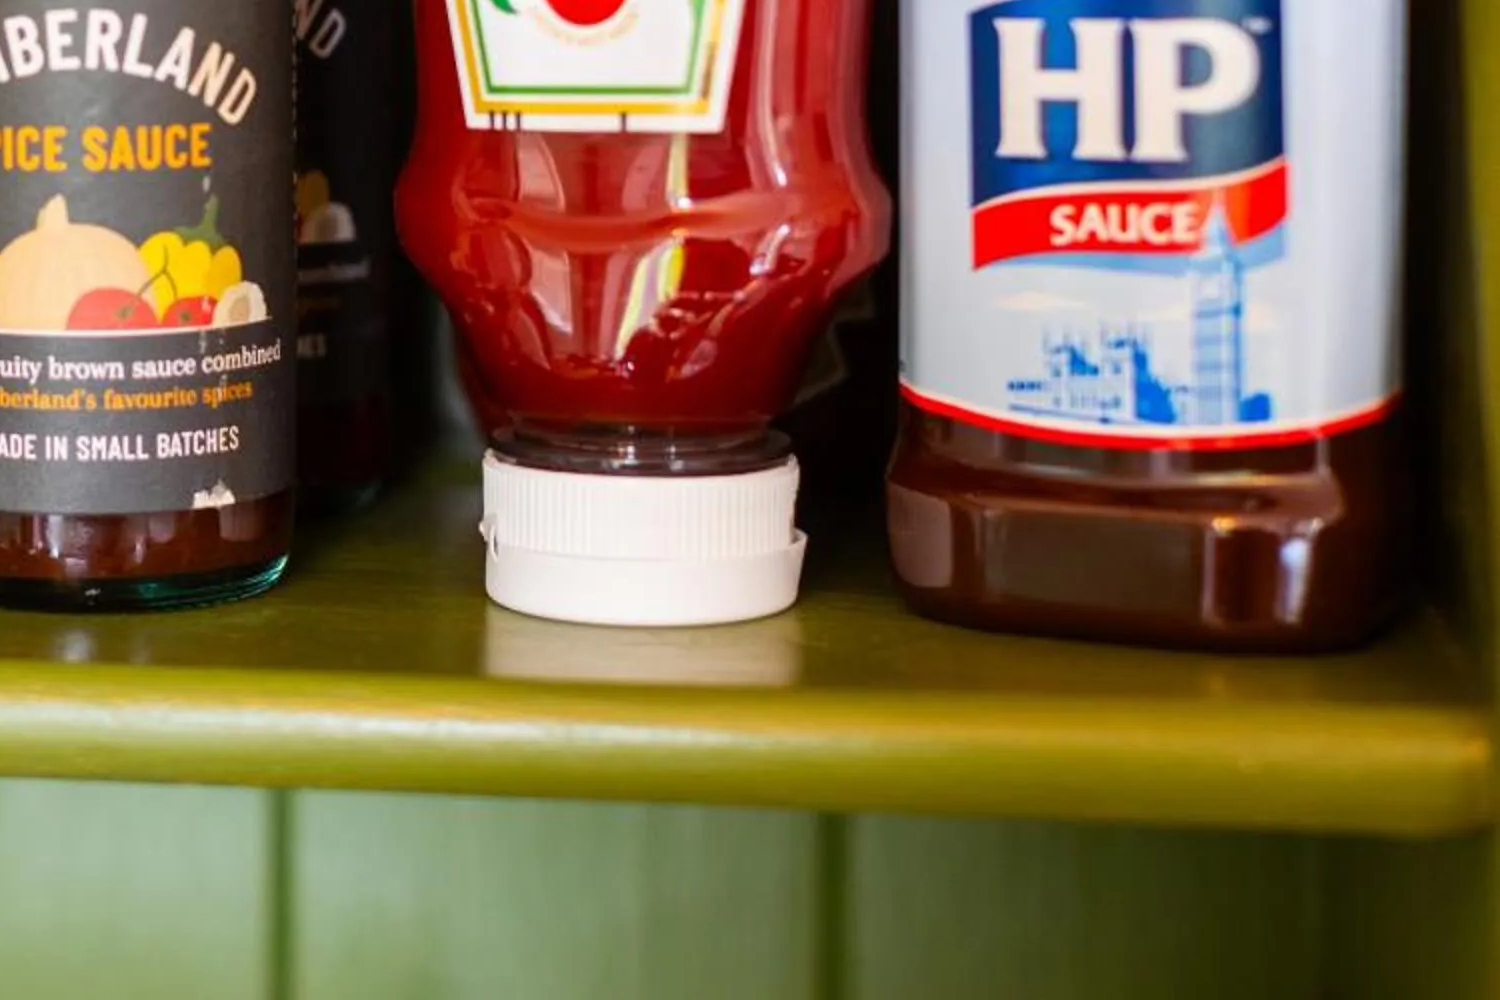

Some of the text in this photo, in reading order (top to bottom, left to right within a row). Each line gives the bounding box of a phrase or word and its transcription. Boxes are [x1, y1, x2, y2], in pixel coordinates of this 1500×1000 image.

[992, 16, 1260, 162] HP
[81, 122, 213, 173] SAUCE
[1049, 202, 1202, 246] SAUCE
[48, 354, 124, 380] brown
[131, 356, 196, 380] sauce
[201, 337, 281, 374] combined
[103, 382, 196, 411] favourite
[202, 381, 252, 409] spices
[45, 436, 70, 461] IN
[76, 434, 149, 462] SMALL
[157, 425, 240, 459] BATCHES
